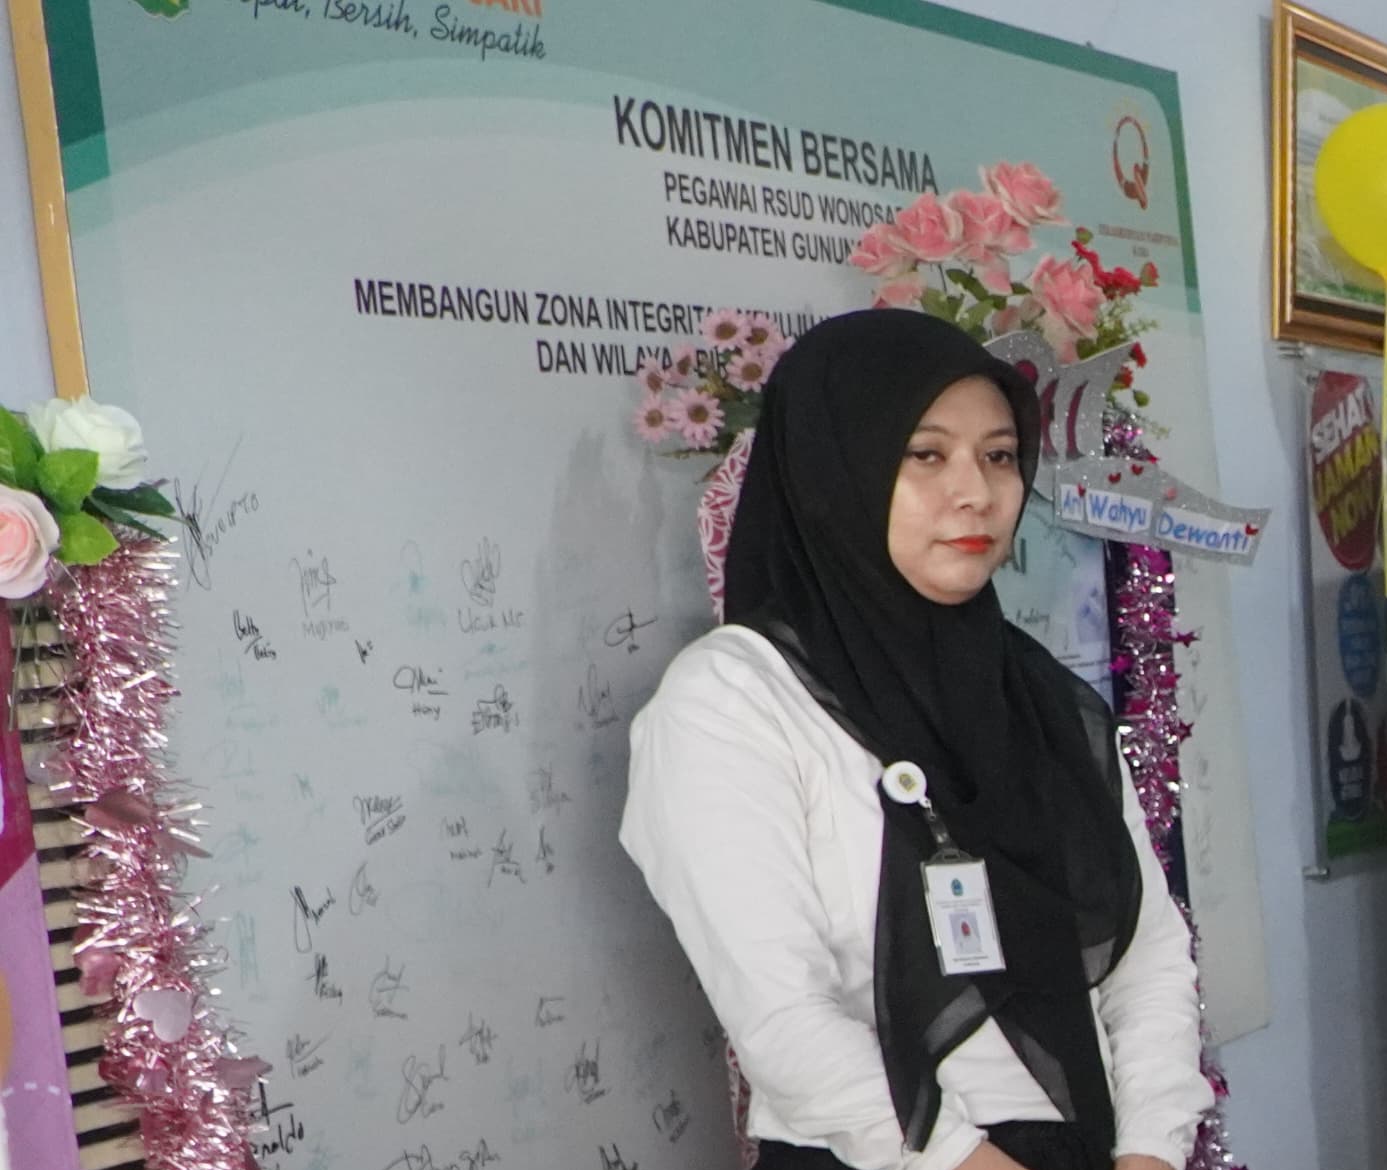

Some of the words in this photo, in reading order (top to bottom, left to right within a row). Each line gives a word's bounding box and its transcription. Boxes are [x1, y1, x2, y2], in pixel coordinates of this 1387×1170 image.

[324, 0, 418, 38] Bersih,
[430, 4, 546, 62] Simpatik
[613, 95, 793, 173] KOMITMEN
[800, 129, 938, 196] BERSAMA
[664, 171, 757, 214] PEGAWAI
[762, 186, 814, 220] RSUD
[818, 194, 901, 228] WONOSA
[666, 215, 787, 259] KABUPATEN
[792, 232, 855, 265] GUNUN
[354, 278, 529, 325] MEMBANGUN
[535, 293, 602, 329] ZONA
[606, 299, 712, 336] INTEGRIT
[536, 340, 588, 375] DAN
[593, 344, 673, 376] WILAYA
[1311, 378, 1374, 466] SEHAT
[1088, 493, 1147, 530] Wahyu
[1156, 512, 1252, 551] Dewanti
